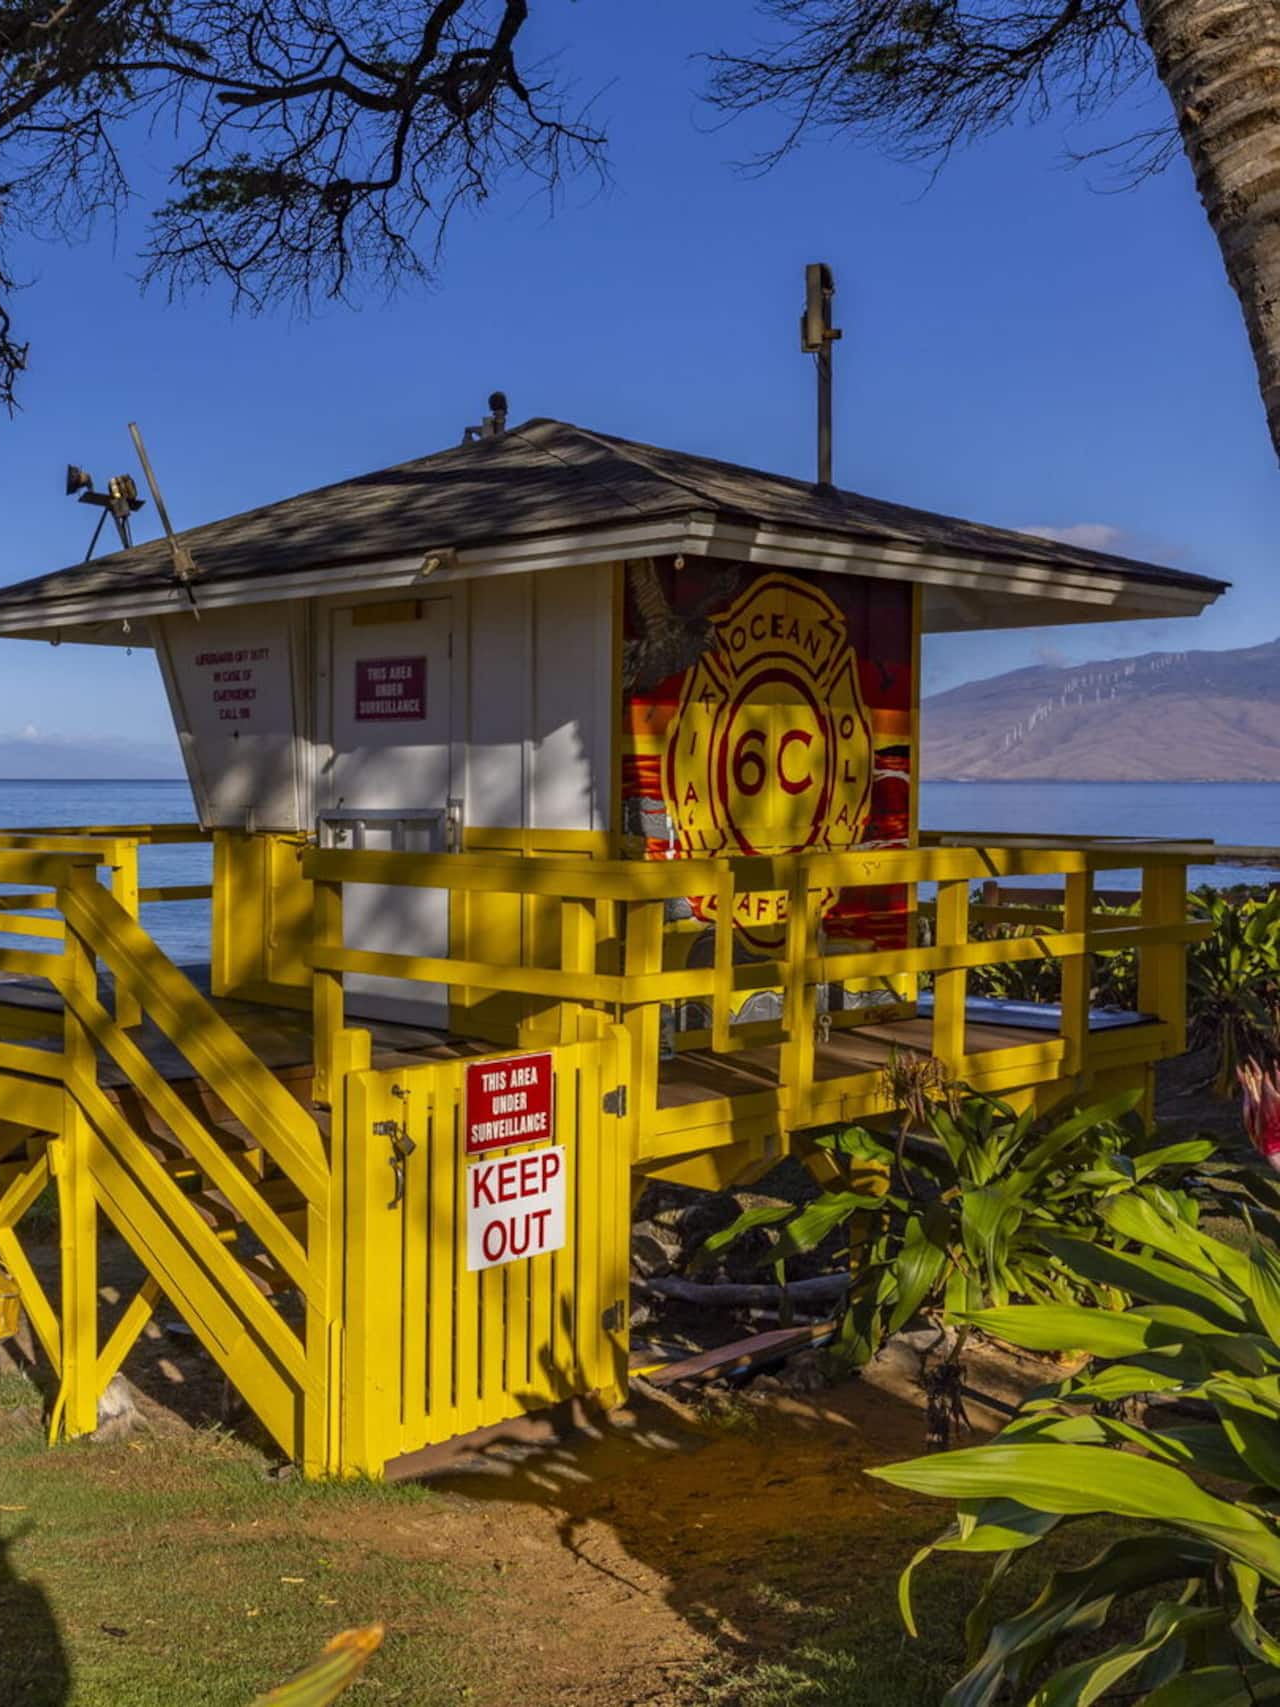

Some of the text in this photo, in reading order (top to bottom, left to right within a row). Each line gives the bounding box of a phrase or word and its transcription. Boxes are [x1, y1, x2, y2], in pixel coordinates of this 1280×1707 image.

[729, 613, 820, 660] OCEAN
[368, 665, 412, 680] THIS AREA
[376, 683, 403, 697] UNDER
[359, 698, 421, 715] SURVEILLANCE
[733, 729, 814, 796] 6C
[482, 1066, 538, 1092] THIS AREA
[492, 1092, 528, 1115] UNDER
[471, 1112, 548, 1144] SURVEILLANCE
[473, 1153, 560, 1209] KEEP
[482, 1208, 552, 1262] OUT
